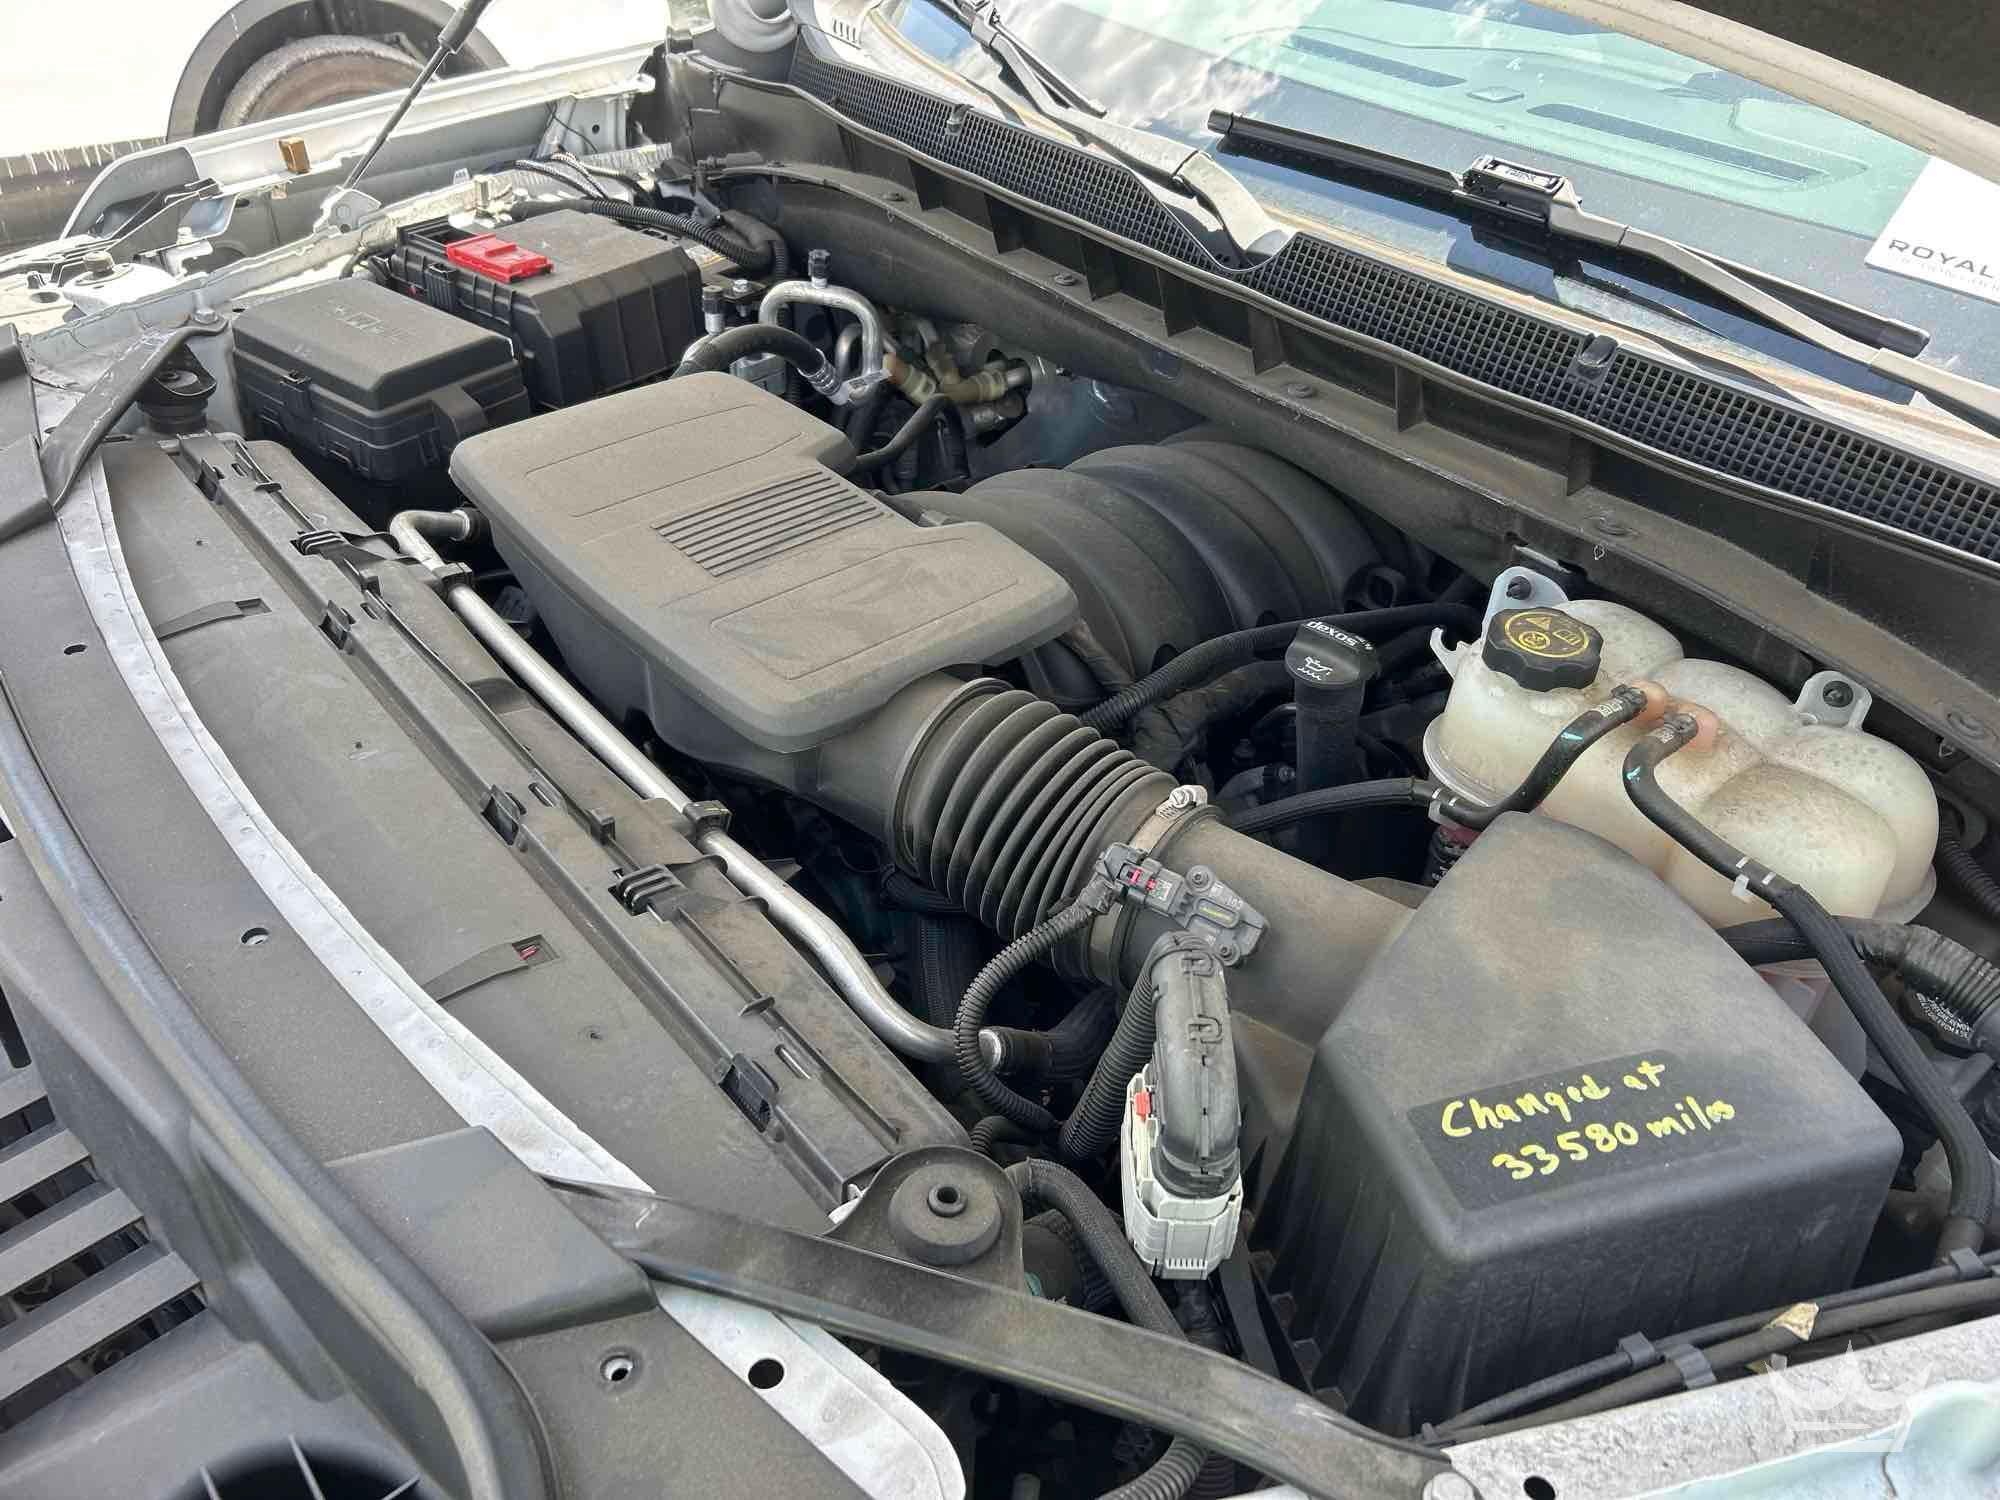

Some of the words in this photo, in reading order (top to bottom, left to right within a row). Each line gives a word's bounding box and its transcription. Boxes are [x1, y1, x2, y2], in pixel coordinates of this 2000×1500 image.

[1888, 239, 1993, 279] ROYAL
[1306, 621, 1358, 647] dexos
[1441, 1073, 1611, 1138] Changed
[1623, 1060, 1666, 1091] at
[1491, 1121, 1640, 1181] 33580
[1646, 1095, 1736, 1138] miles
